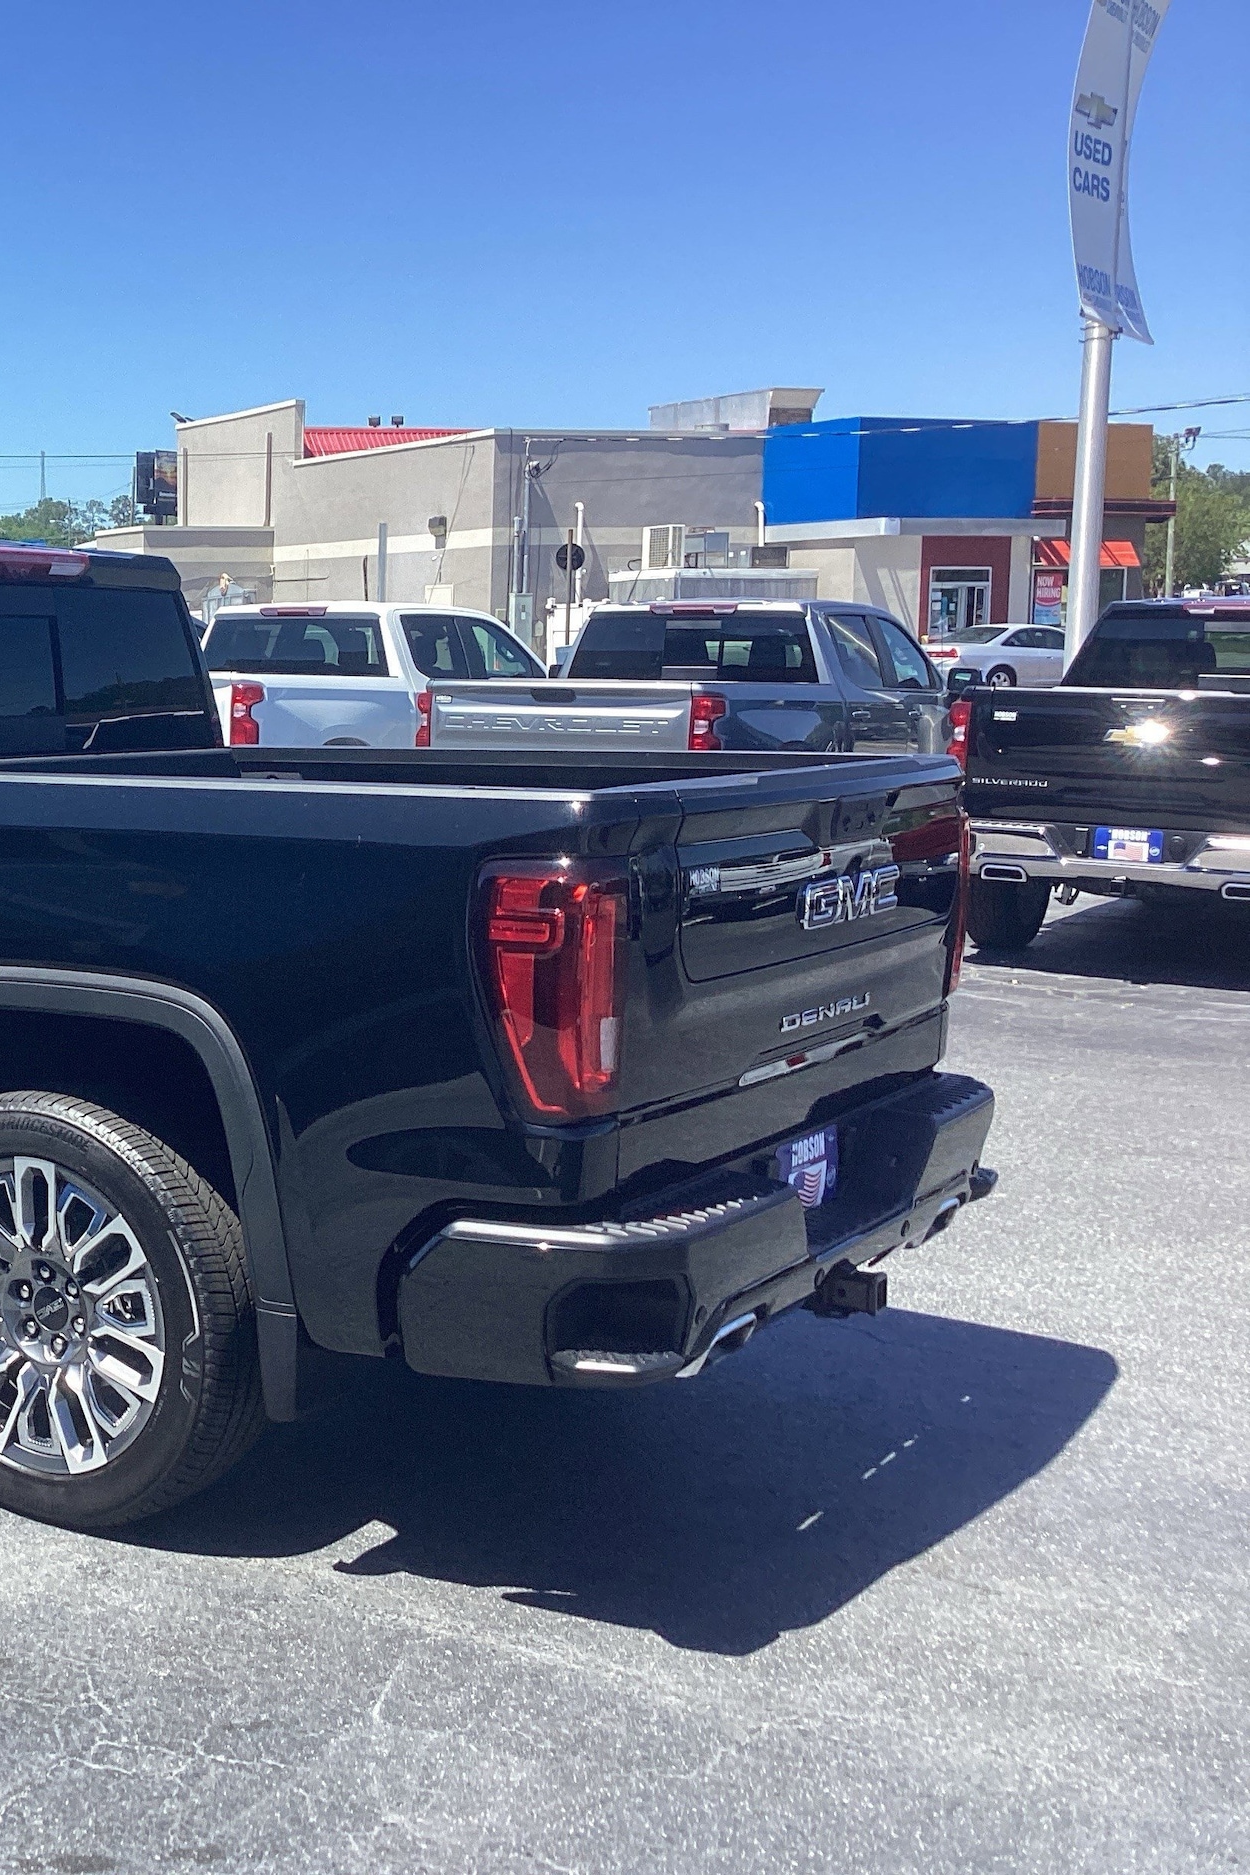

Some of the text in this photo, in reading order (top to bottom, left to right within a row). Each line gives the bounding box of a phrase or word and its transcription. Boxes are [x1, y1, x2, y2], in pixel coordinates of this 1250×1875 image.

[1075, 130, 1113, 167] USED
[1073, 166, 1110, 203] CARS
[1077, 262, 1111, 297] HOBSON
[1036, 587, 1061, 599] HIRING
[1037, 576, 1055, 587] NOW
[972, 777, 1048, 788] SILVERADO
[1111, 828, 1148, 842] HOBSON
[689, 867, 720, 887] HOBSON
[803, 864, 900, 930] GMC
[780, 991, 871, 1033] DENALI
[791, 1131, 826, 1168] HOBSON
